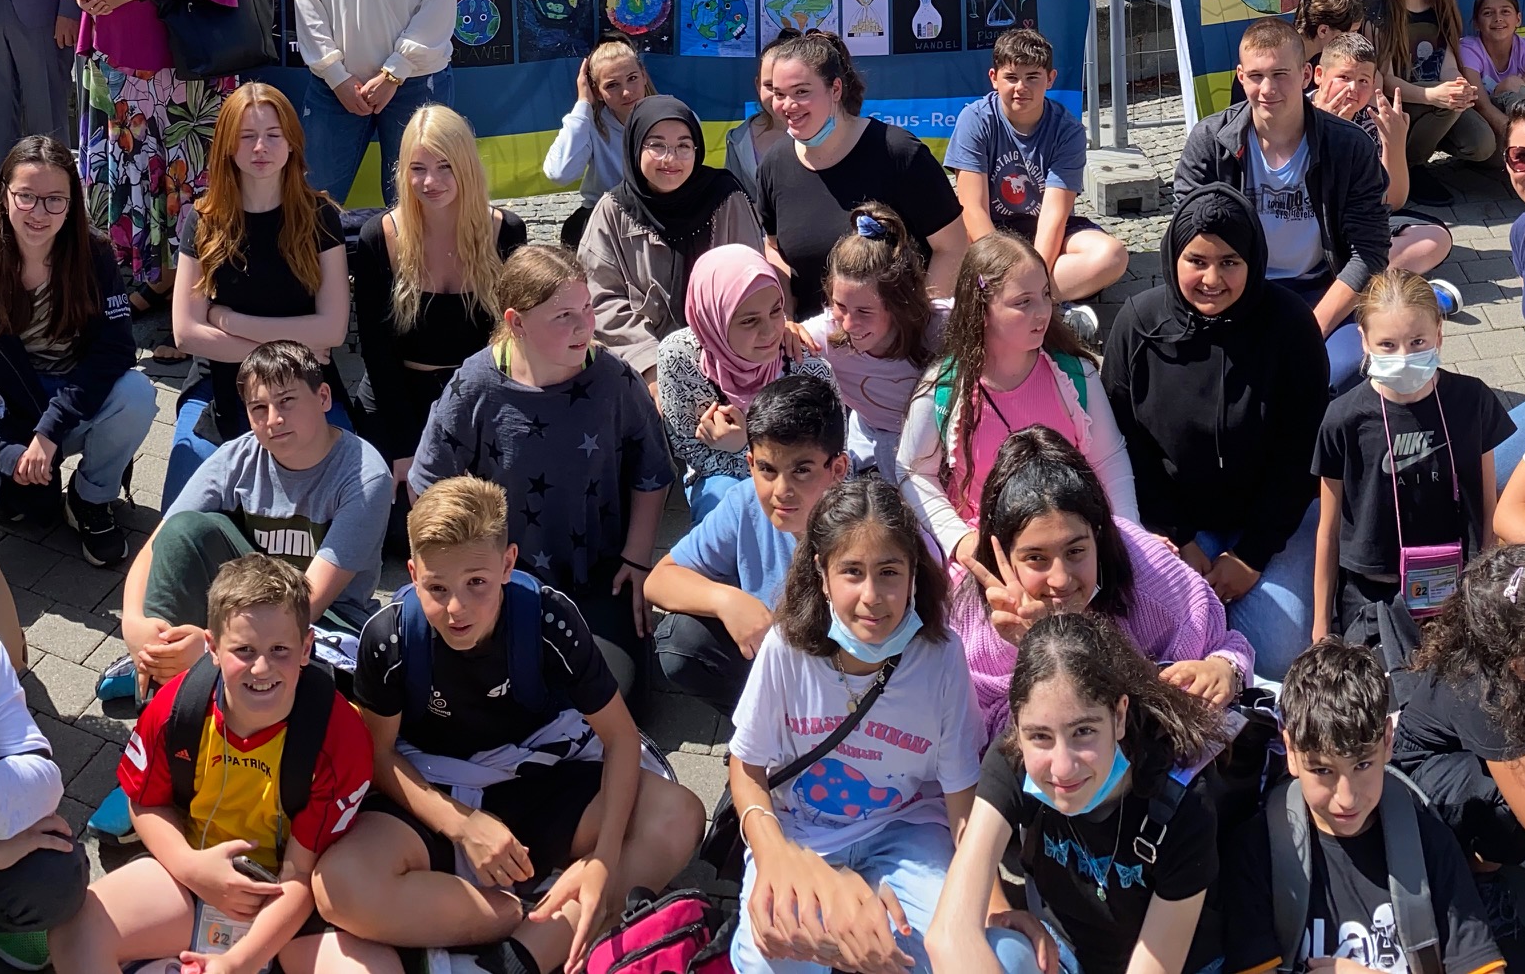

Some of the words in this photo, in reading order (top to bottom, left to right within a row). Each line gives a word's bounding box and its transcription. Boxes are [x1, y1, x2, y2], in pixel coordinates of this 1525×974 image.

[914, 39, 959, 51] WANDEL
[1393, 430, 1435, 456] NIKE
[1415, 582, 1428, 596] 22
[223, 754, 273, 778] PATRICK
